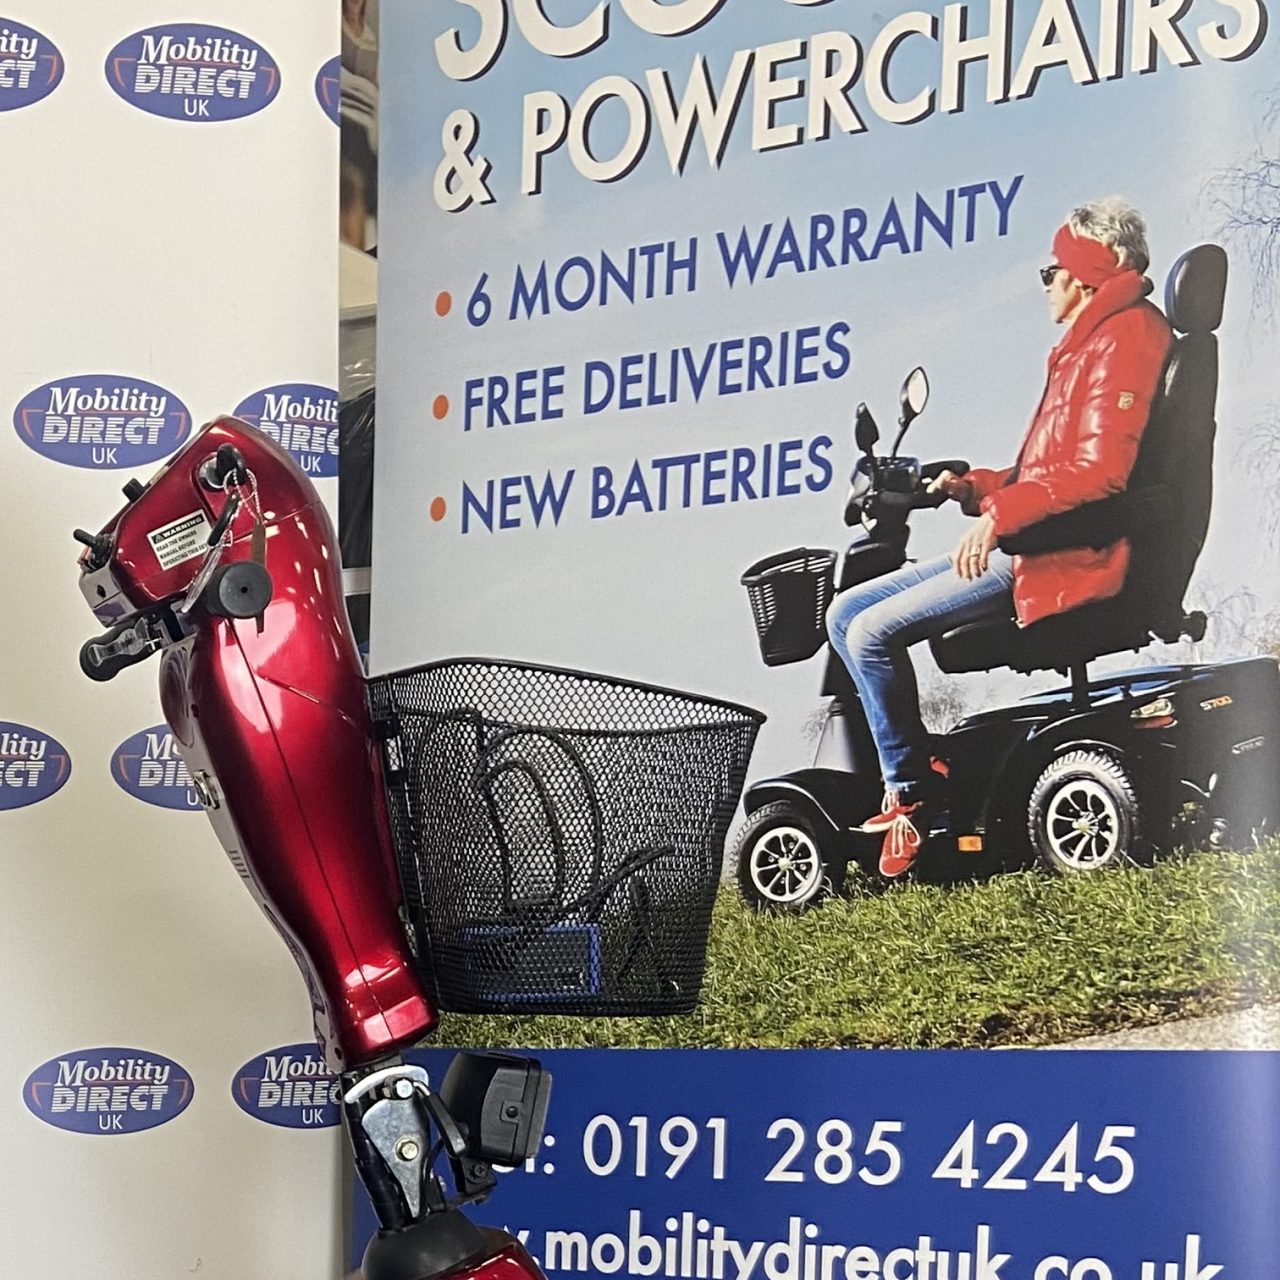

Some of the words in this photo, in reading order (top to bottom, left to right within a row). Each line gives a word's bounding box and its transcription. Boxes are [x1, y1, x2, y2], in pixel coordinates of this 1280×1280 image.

[138, 36, 257, 70] Mobility
[135, 65, 255, 98] DIRECT
[185, 99, 209, 116] UK
[433, 108, 496, 213] &
[521, 0, 1269, 196] POWERCHAIRS
[466, 272, 491, 327] 6
[509, 237, 698, 321] MONTH
[716, 175, 1024, 289] WARRANTY
[464, 365, 565, 432] FREE
[583, 321, 851, 416] DELIVERIES
[46, 388, 166, 417] Mobility
[260, 394, 338, 422] Mobili
[43, 416, 165, 444] DIRECT
[93, 448, 117, 464] UK
[301, 455, 320, 472] UK
[461, 469, 575, 535] NEW
[591, 435, 833, 519] BATTERIES
[162, 516, 202, 538] WARNING
[54, 1060, 169, 1086] Mobility
[51, 1083, 168, 1112] DIRECT
[258, 1081, 341, 1107] DIREC
[100, 1115, 122, 1129] UK
[303, 1109, 323, 1124] UK
[583, 1114, 726, 1180] 0191
[765, 1118, 903, 1186] 285
[933, 1120, 1136, 1194] 4245
